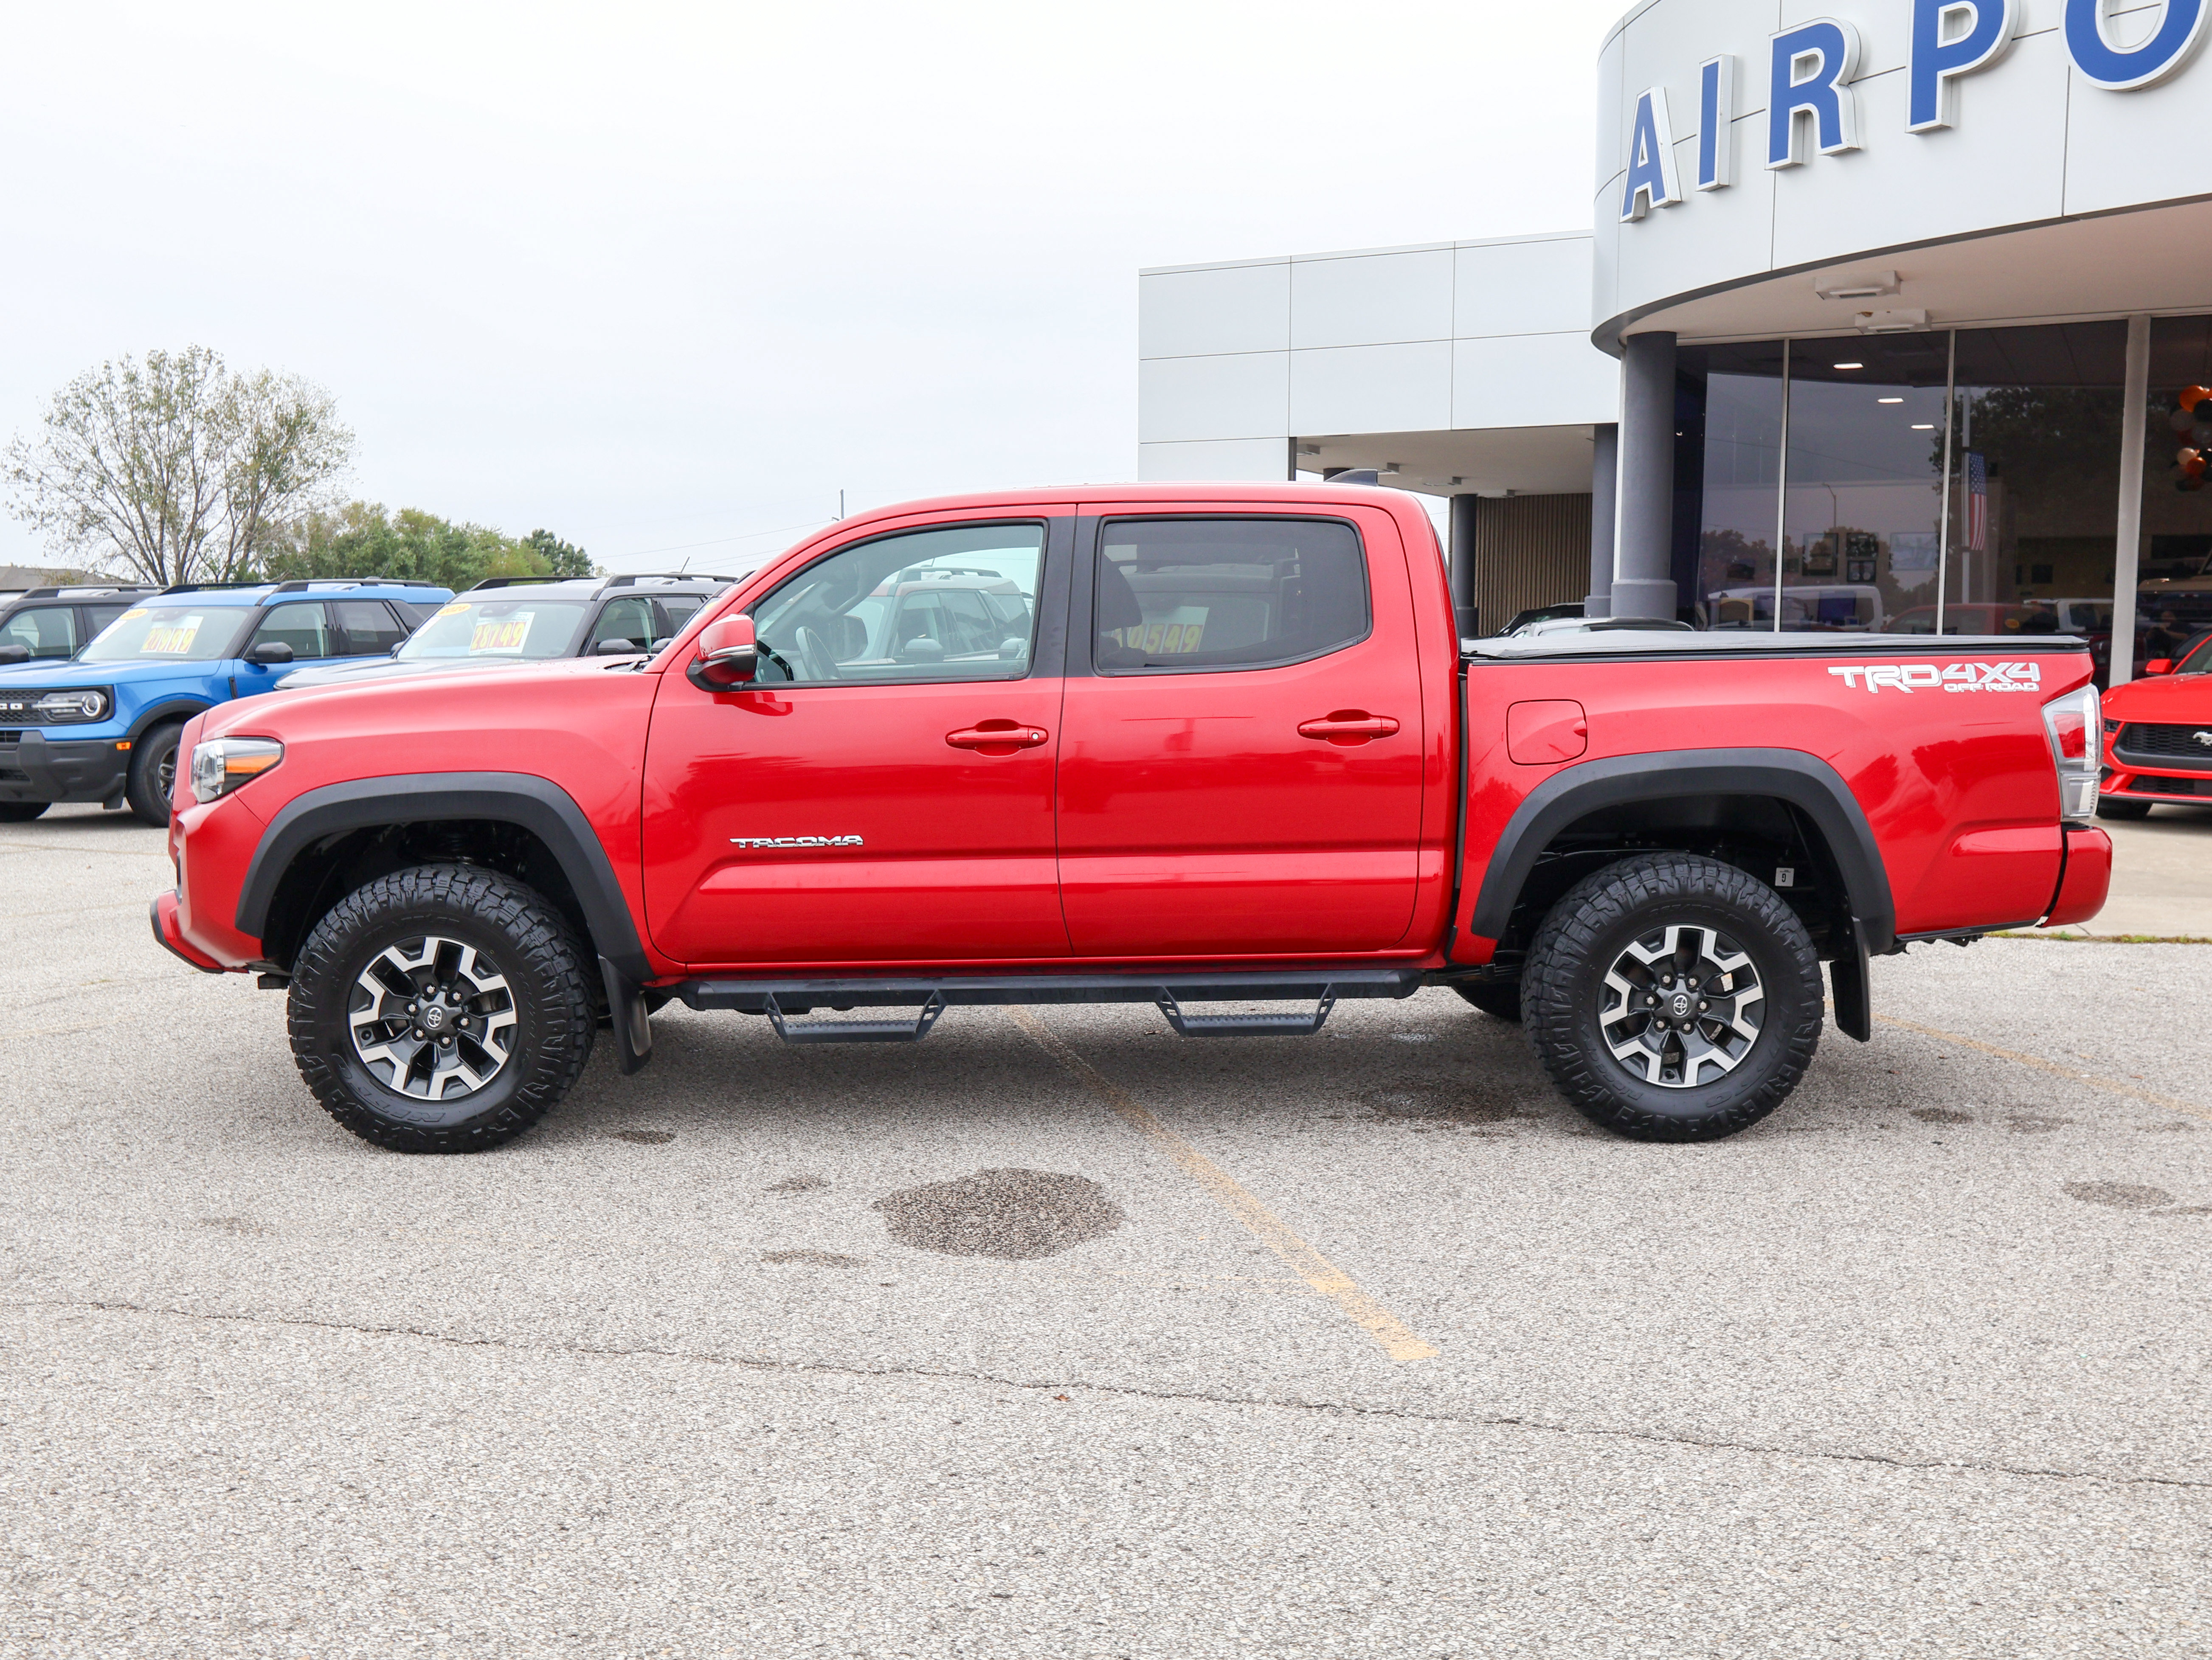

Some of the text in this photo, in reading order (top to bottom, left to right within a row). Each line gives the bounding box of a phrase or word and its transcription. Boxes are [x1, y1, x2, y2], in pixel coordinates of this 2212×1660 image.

[470, 622, 525, 650] 28749
[1827, 664, 1942, 693] TRD
[1944, 682, 2040, 693] OFF ROAD
[729, 835, 863, 848] TACOMA
